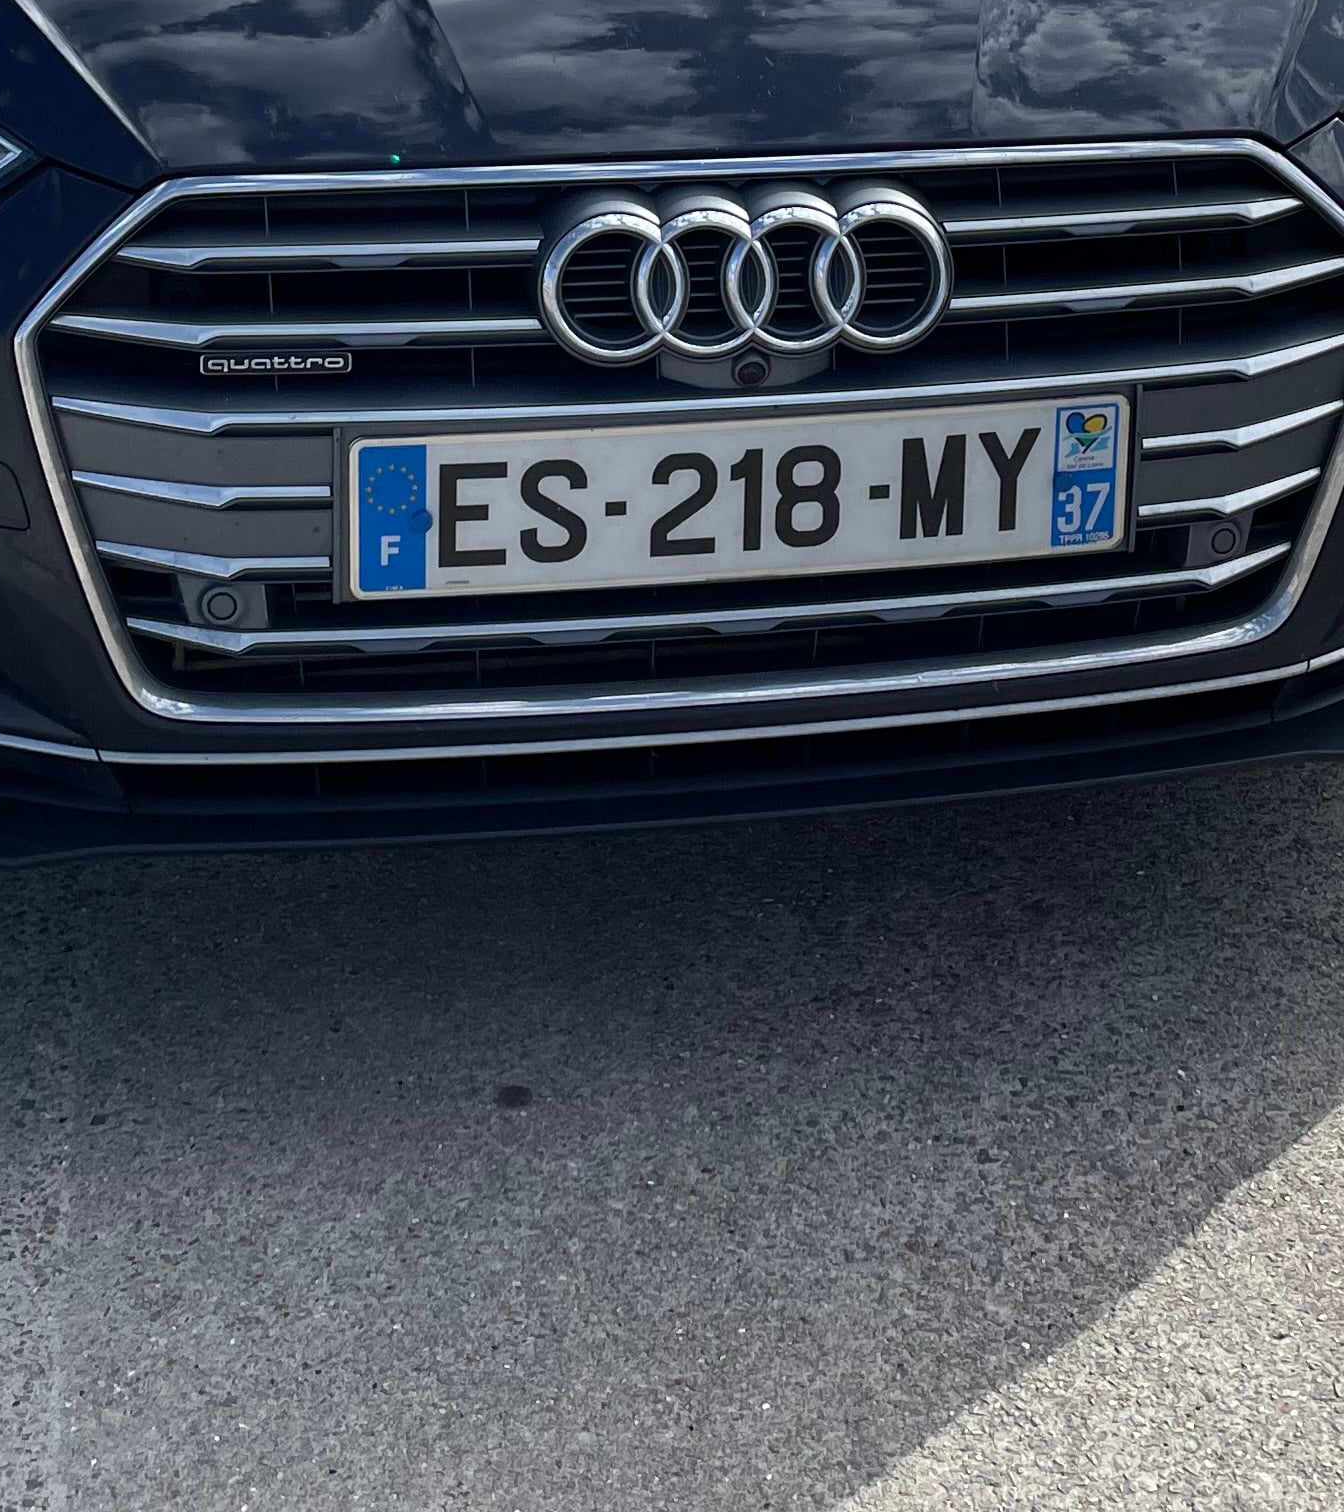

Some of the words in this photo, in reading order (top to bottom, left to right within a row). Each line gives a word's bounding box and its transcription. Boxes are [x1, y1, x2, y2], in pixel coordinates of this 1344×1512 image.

[207, 355, 345, 373] quattro
[437, 427, 1042, 568] ES-218-MY
[1057, 482, 1110, 533] 37
[380, 534, 401, 567] F
